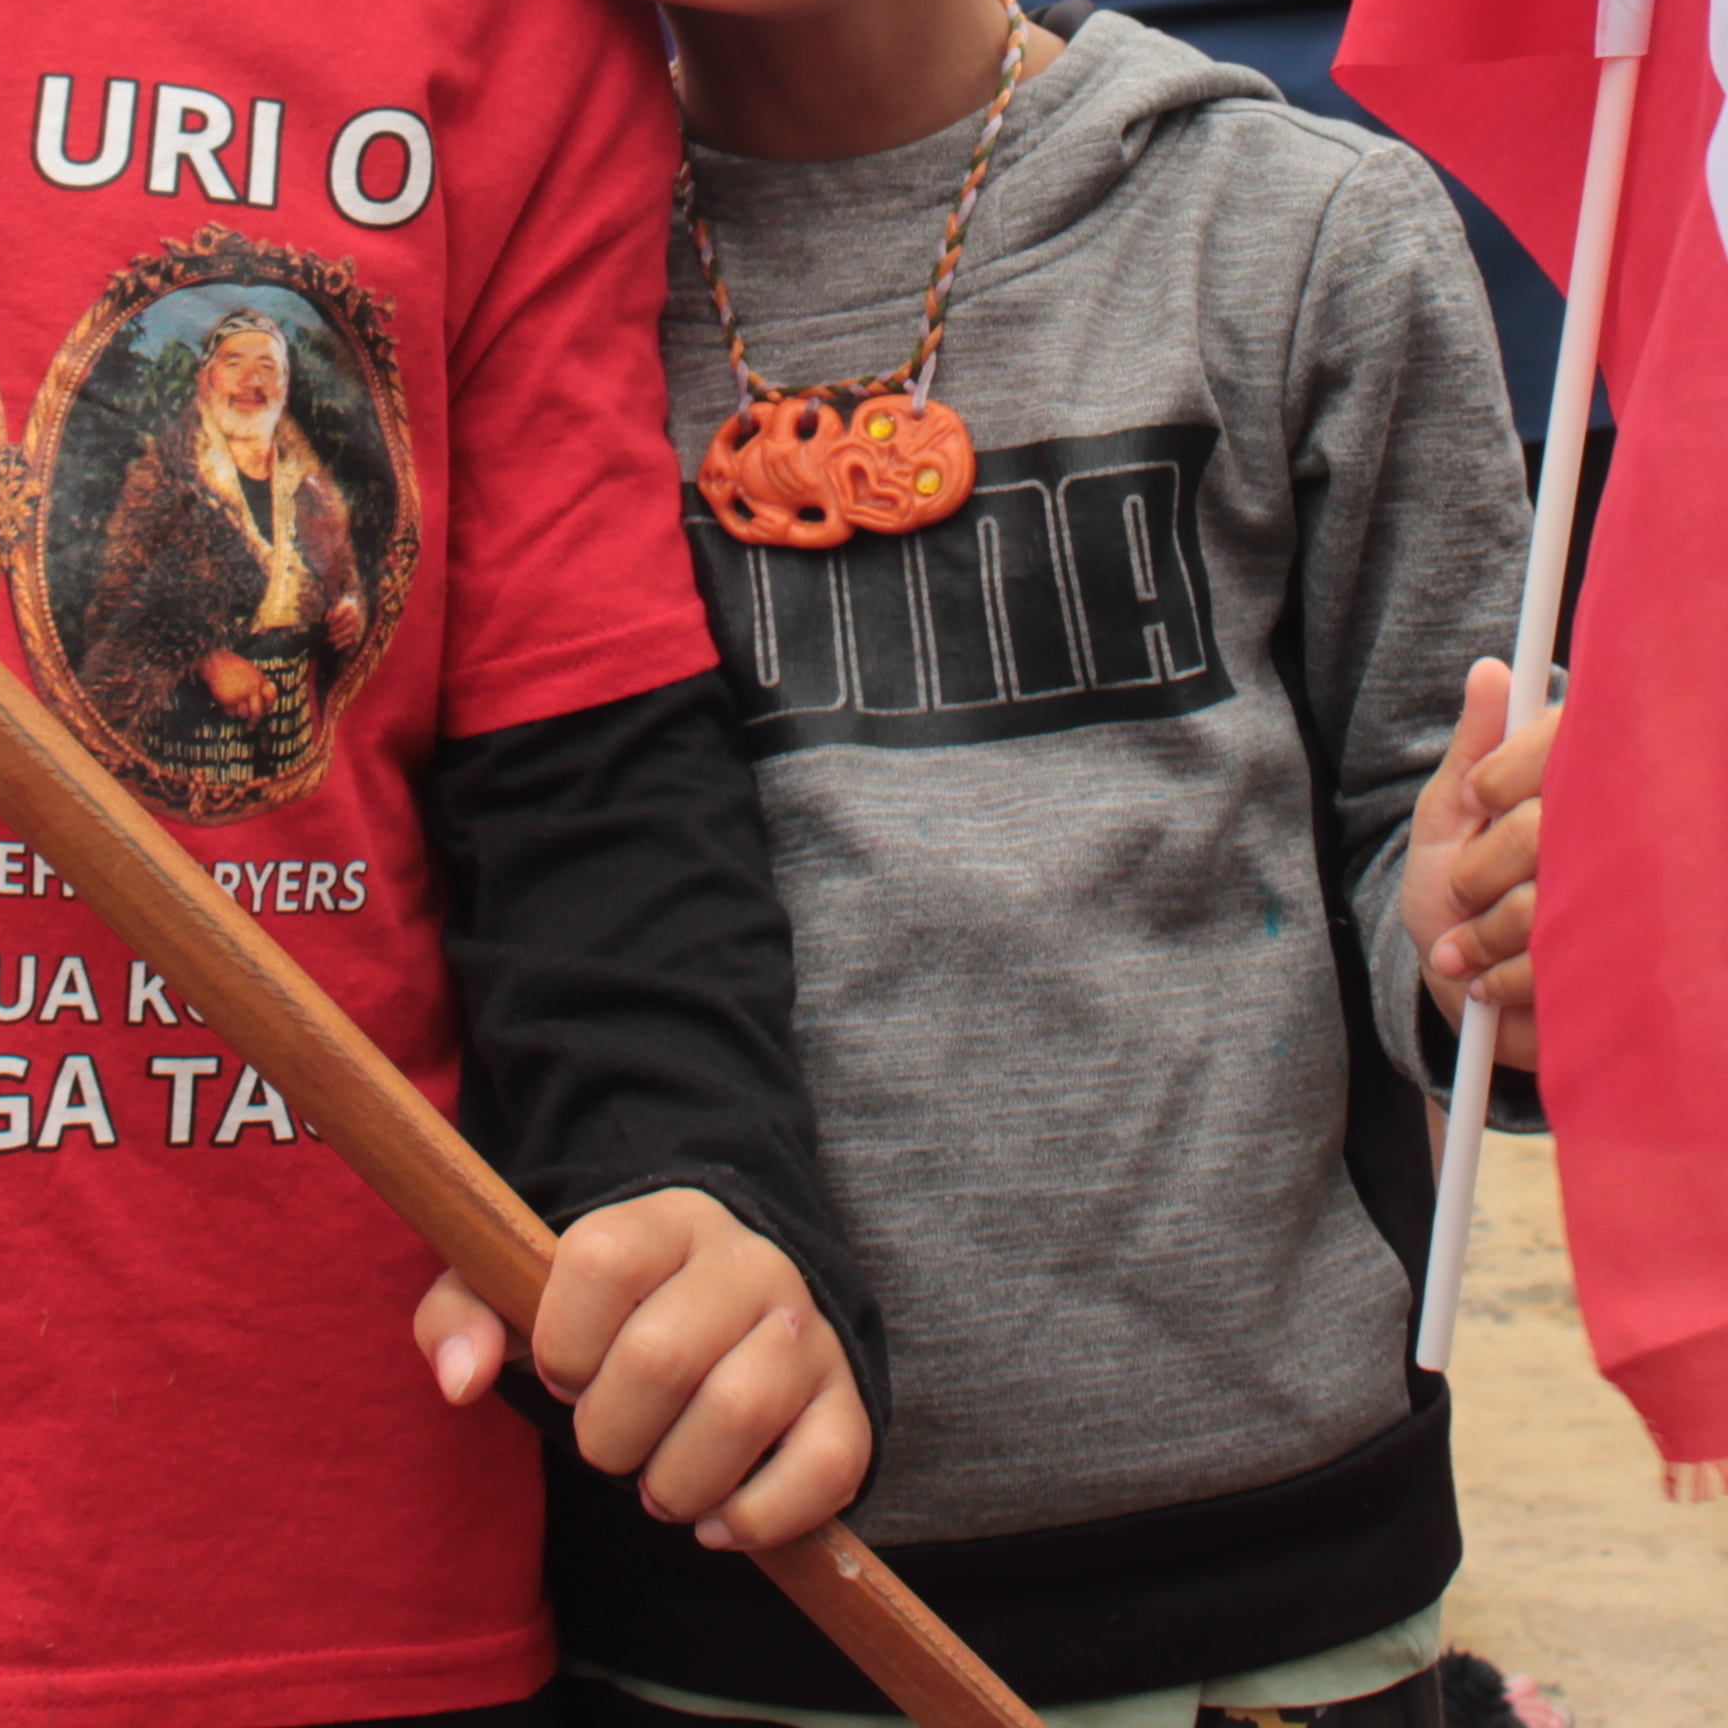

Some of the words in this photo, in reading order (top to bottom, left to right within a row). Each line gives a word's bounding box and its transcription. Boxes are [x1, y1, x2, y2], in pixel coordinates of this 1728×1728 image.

[32, 71, 284, 209] URI
[327, 106, 435, 229] O
[202, 858, 368, 914] RYERS
[125, 959, 209, 1027] K
[146, 1054, 326, 1150] TA
